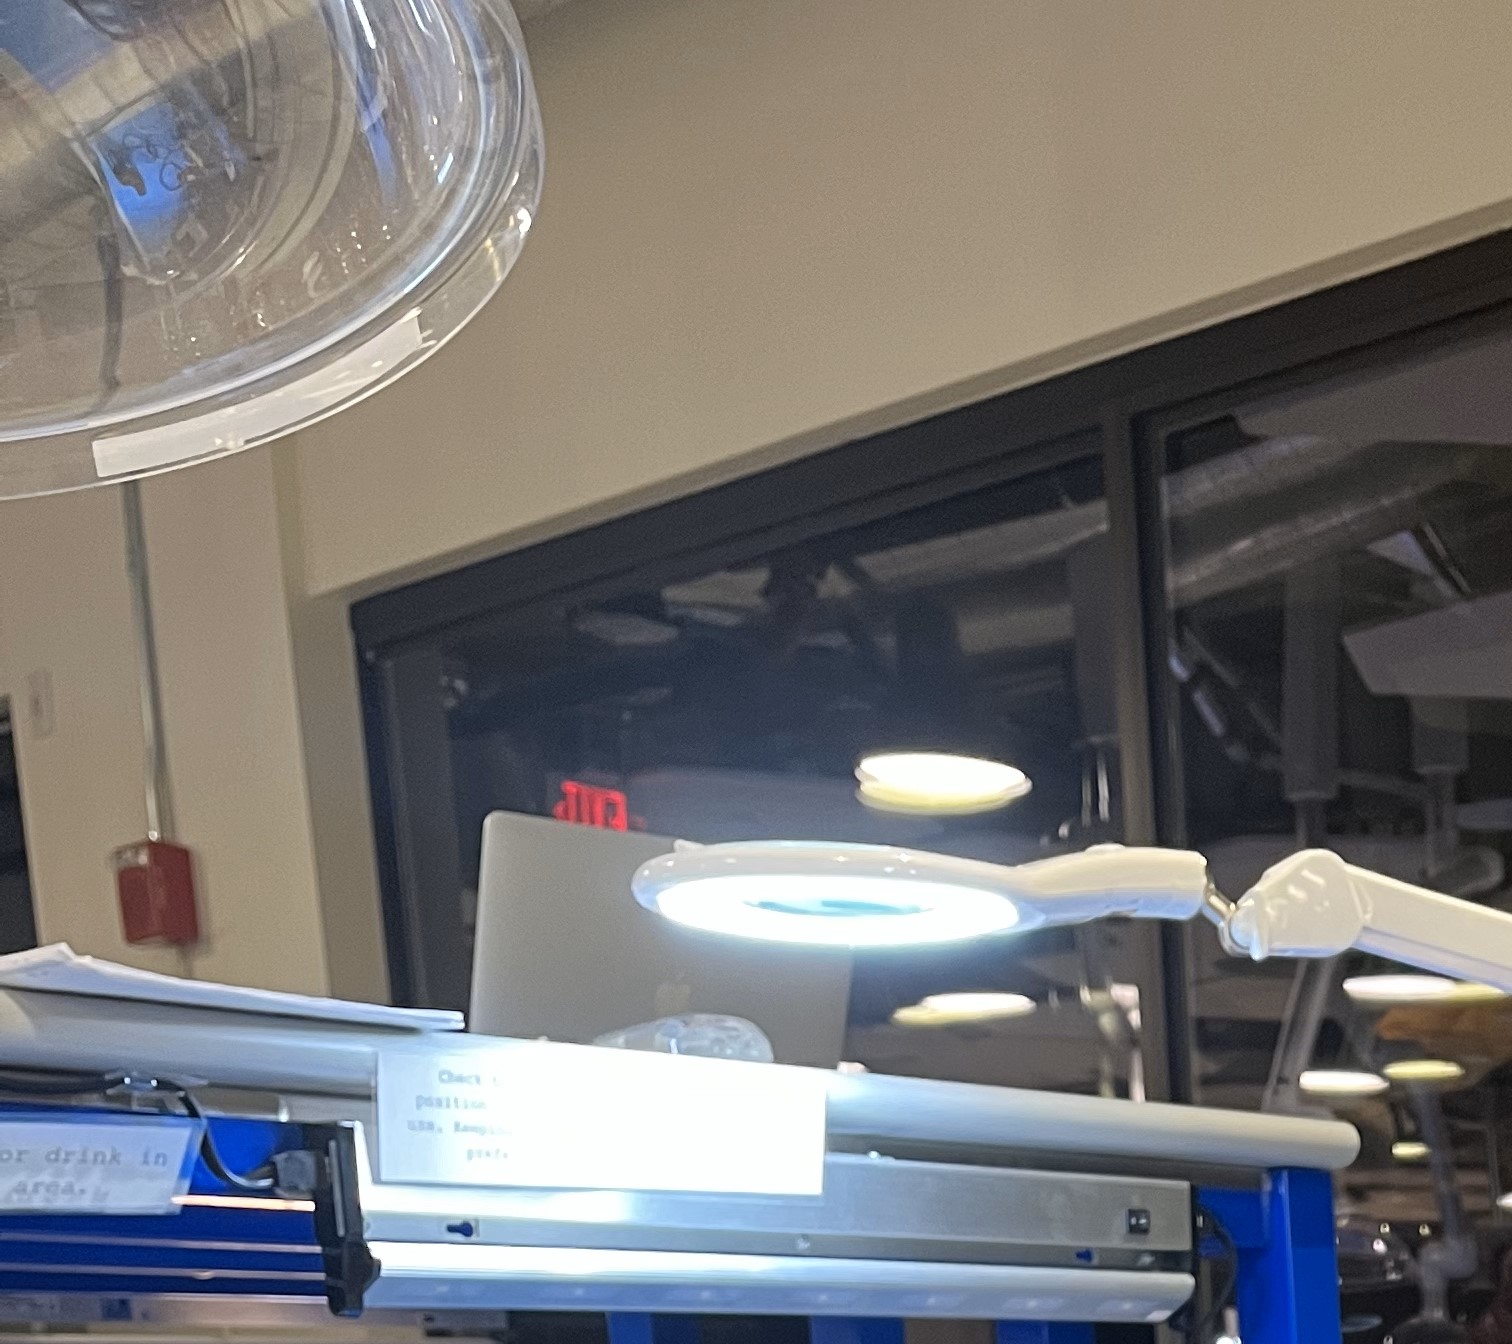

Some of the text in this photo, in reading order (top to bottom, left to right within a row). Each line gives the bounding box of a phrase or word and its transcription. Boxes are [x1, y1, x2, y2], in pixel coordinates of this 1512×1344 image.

[44, 1145, 121, 1167] drink
[142, 1147, 168, 1167] in
[12, 1180, 86, 1196] area.
